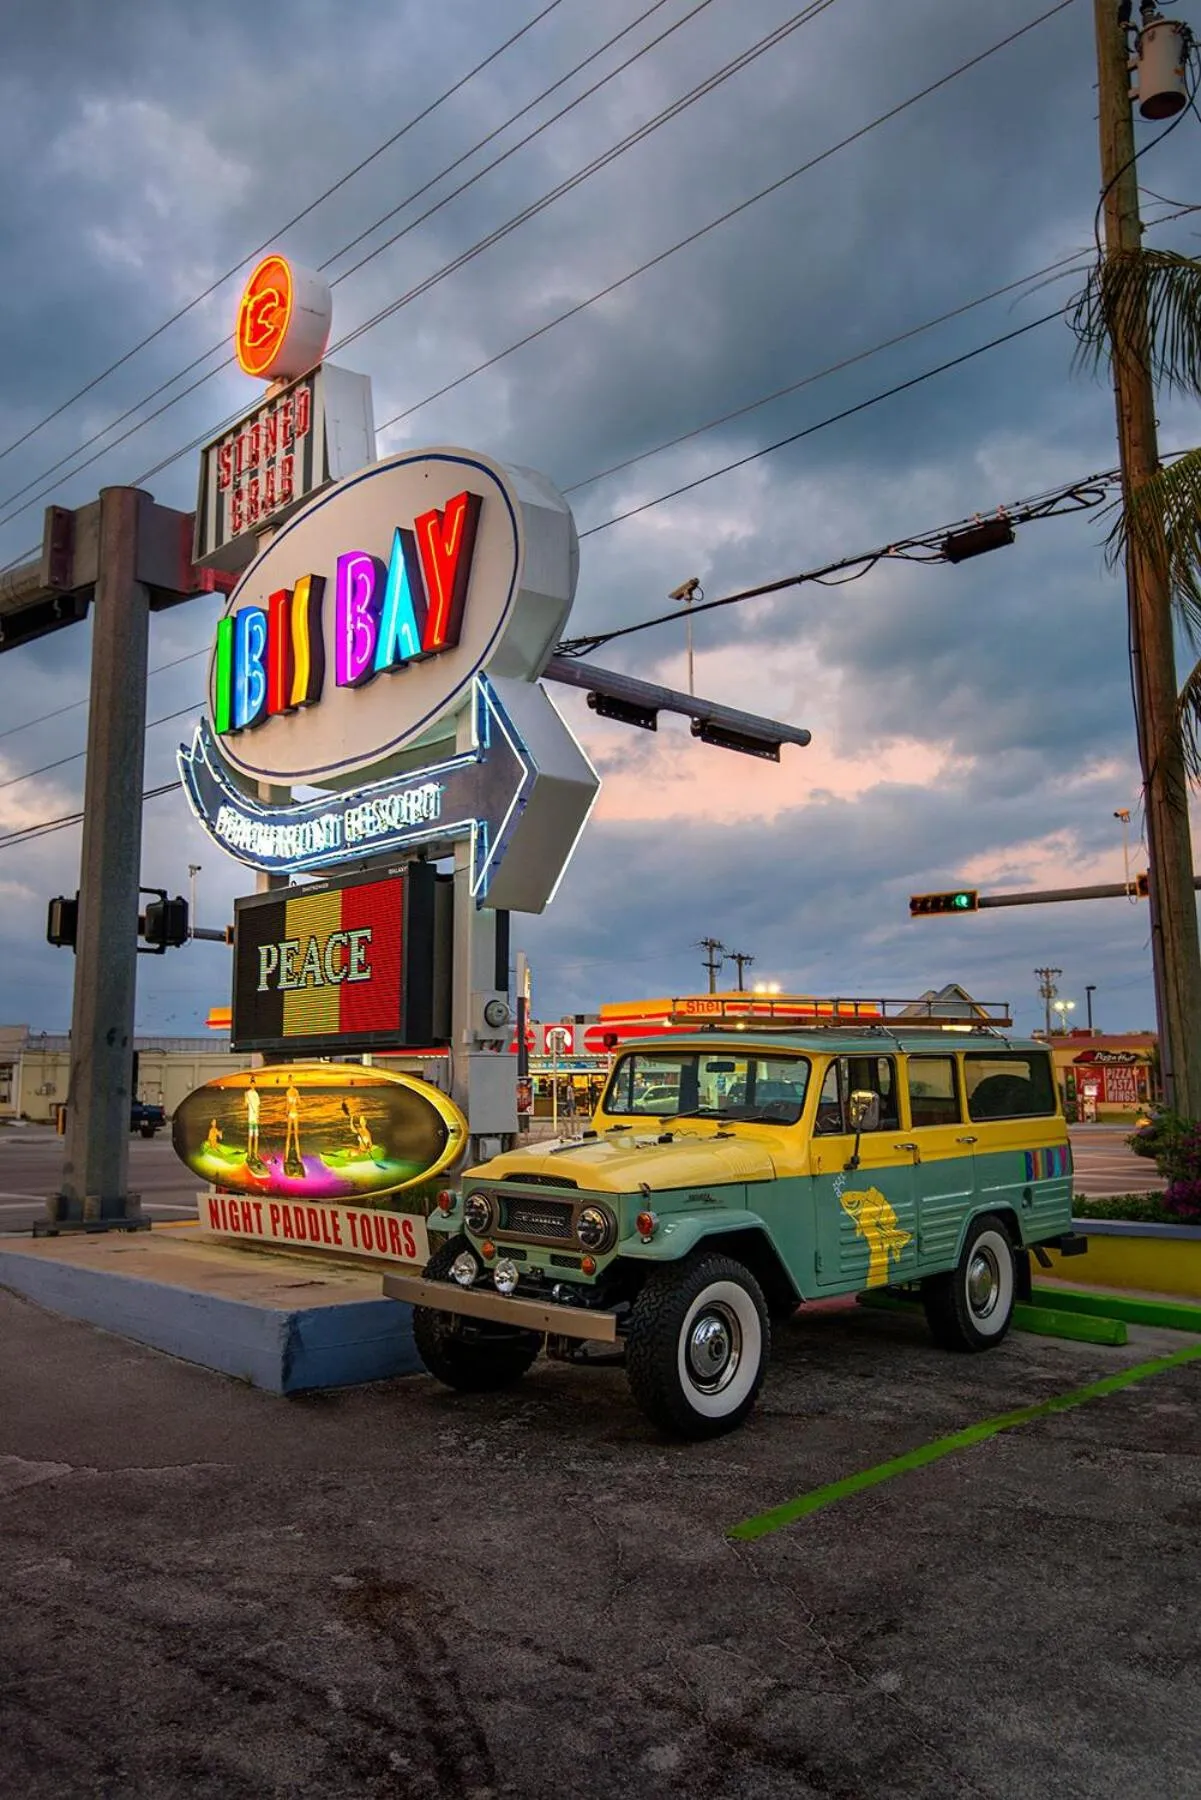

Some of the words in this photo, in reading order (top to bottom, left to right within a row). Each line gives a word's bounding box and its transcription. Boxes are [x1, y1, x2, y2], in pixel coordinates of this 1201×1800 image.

[217, 387, 311, 493] STONED
[231, 454, 294, 535] CRAB
[215, 573, 327, 735] IBIS
[335, 490, 484, 689] BAY
[345, 782, 443, 841] RESORT
[257, 928, 372, 991] PEACE
[686, 1000, 724, 1014] Shel
[1106, 1067, 1131, 1080] PIZZA
[1108, 1080, 1133, 1091] PASTA
[1108, 1091, 1136, 1102] WINGS
[208, 1198, 263, 1234] NIGHT
[270, 1204, 343, 1247] PADDLE
[347, 1212, 417, 1259] TOURS
